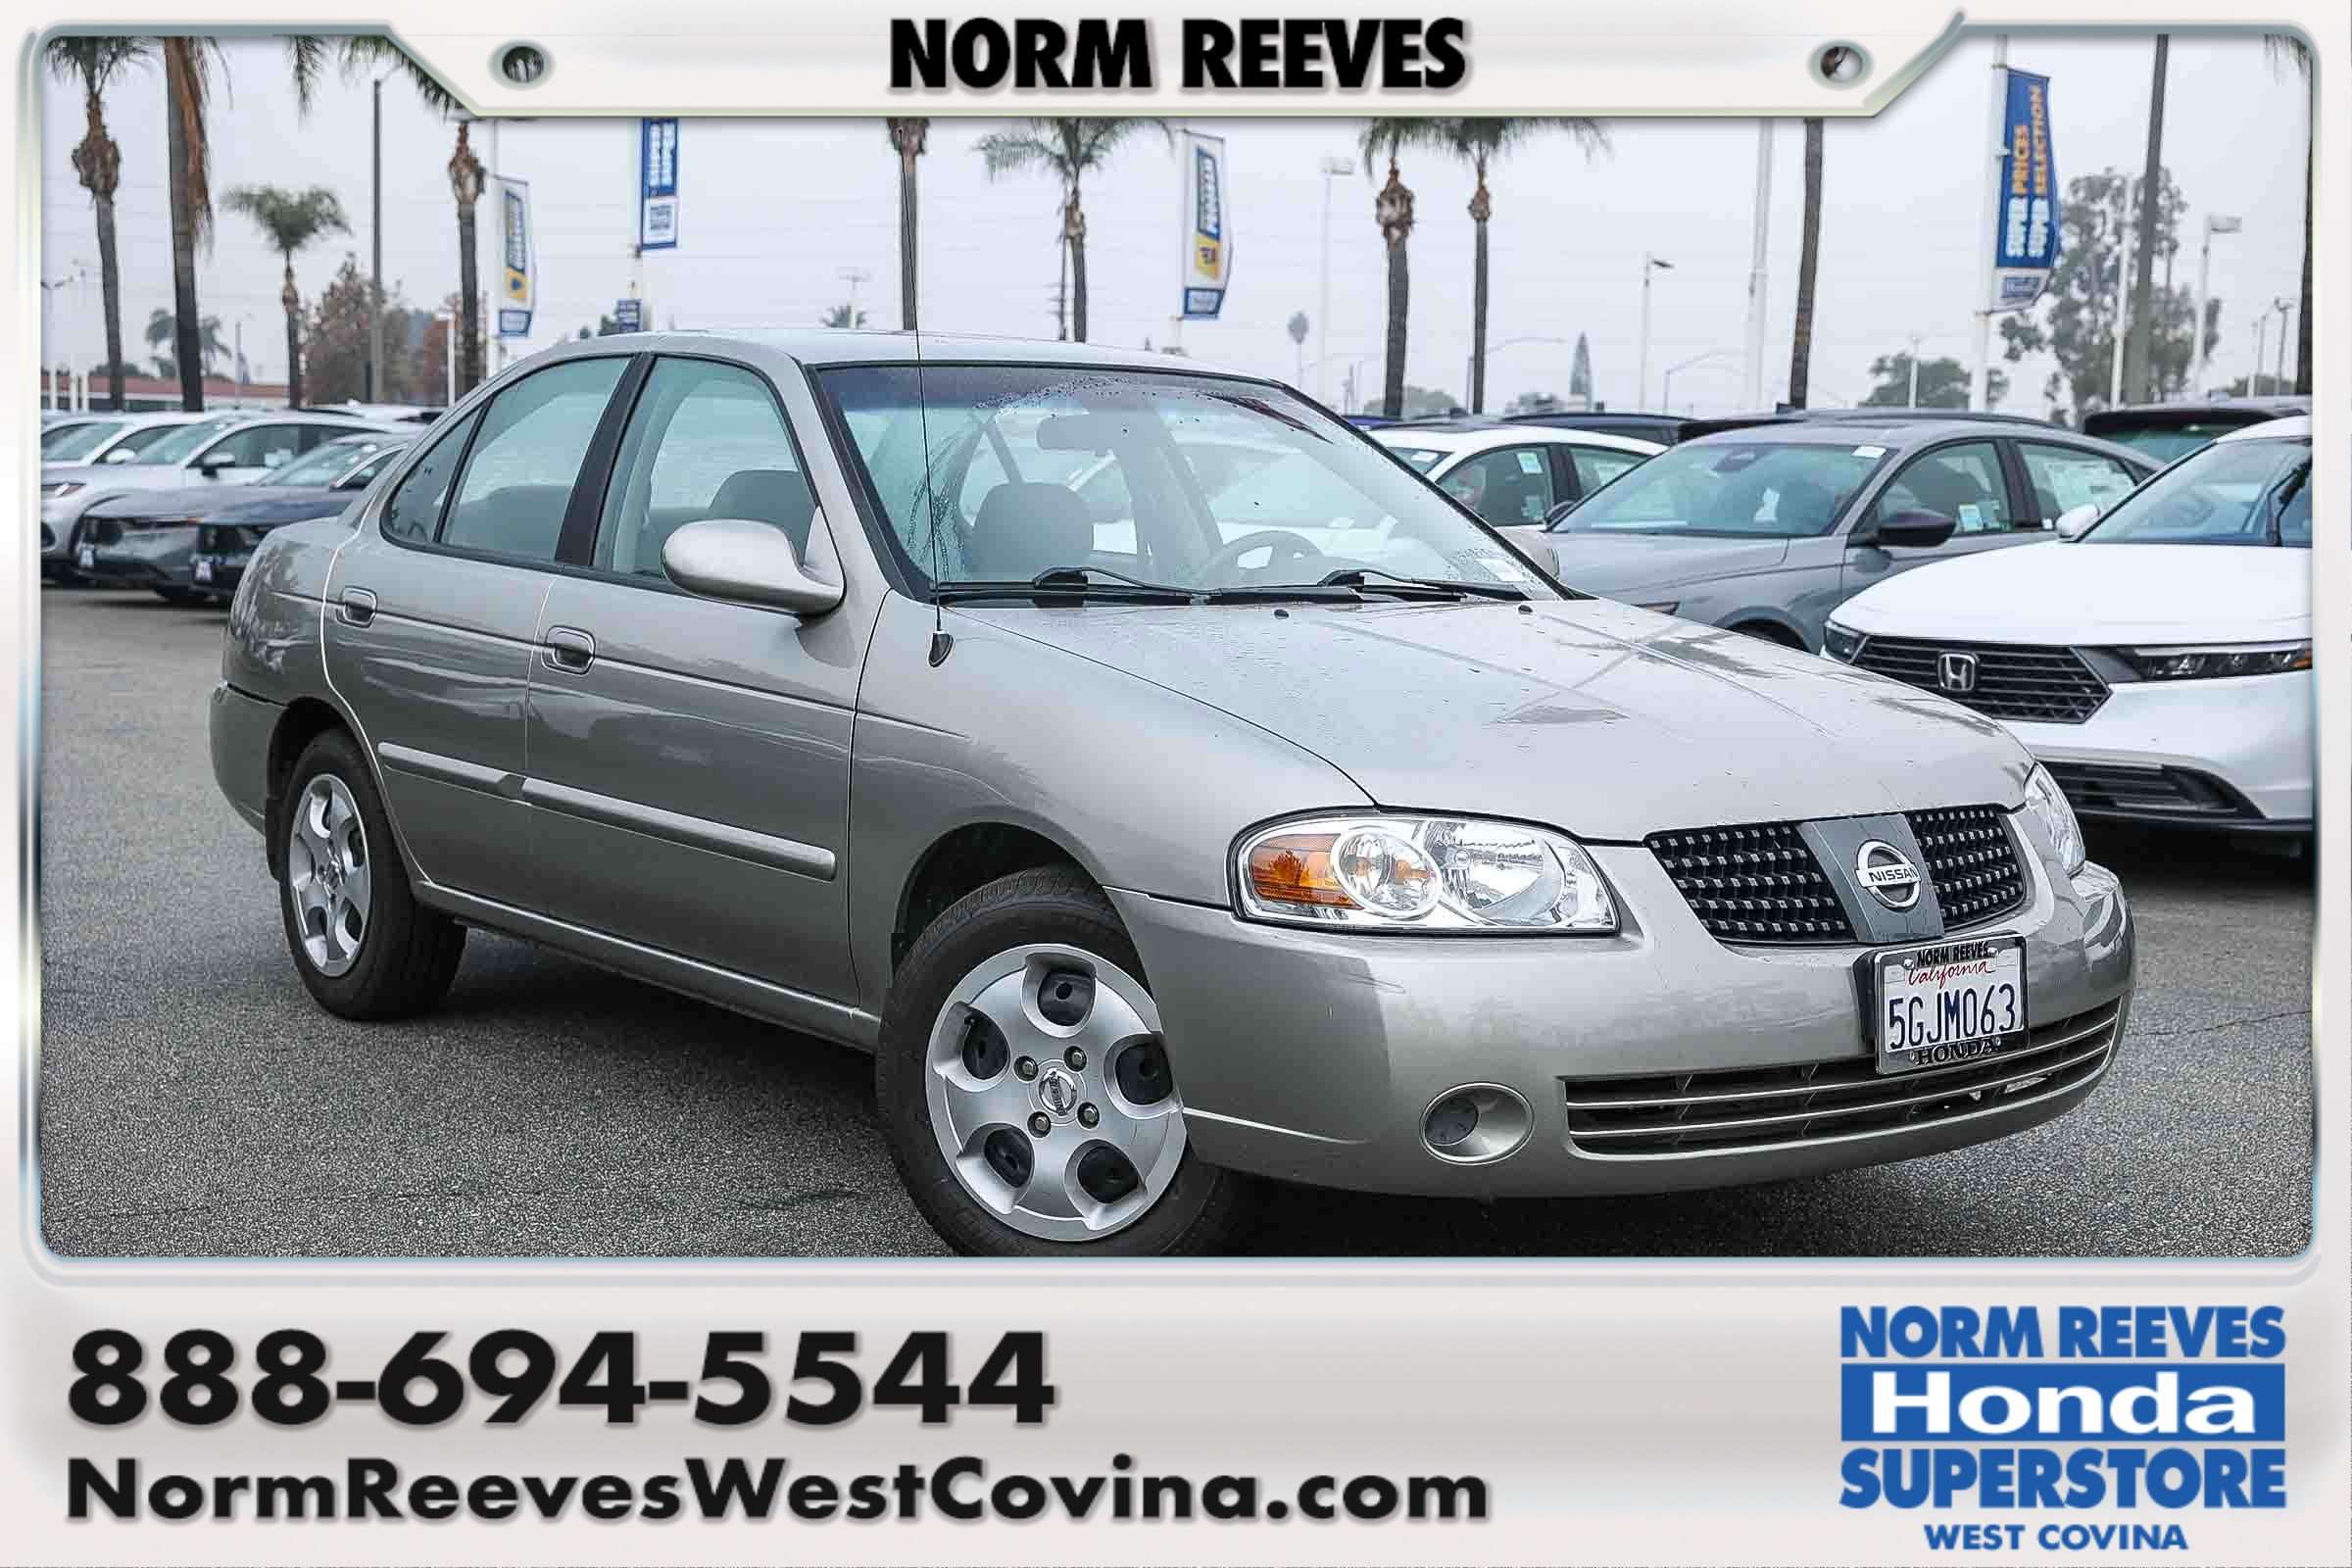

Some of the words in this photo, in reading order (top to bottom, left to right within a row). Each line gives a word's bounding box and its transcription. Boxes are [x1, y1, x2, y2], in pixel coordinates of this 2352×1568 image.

[1868, 867, 1919, 882] NISSAN
[1917, 947, 1950, 967] NORM
[1953, 941, 1990, 961] REEVES
[1908, 960, 1996, 989] California
[1888, 983, 2016, 1050] 5GJM063
[1915, 1037, 1993, 1065] HONDA
